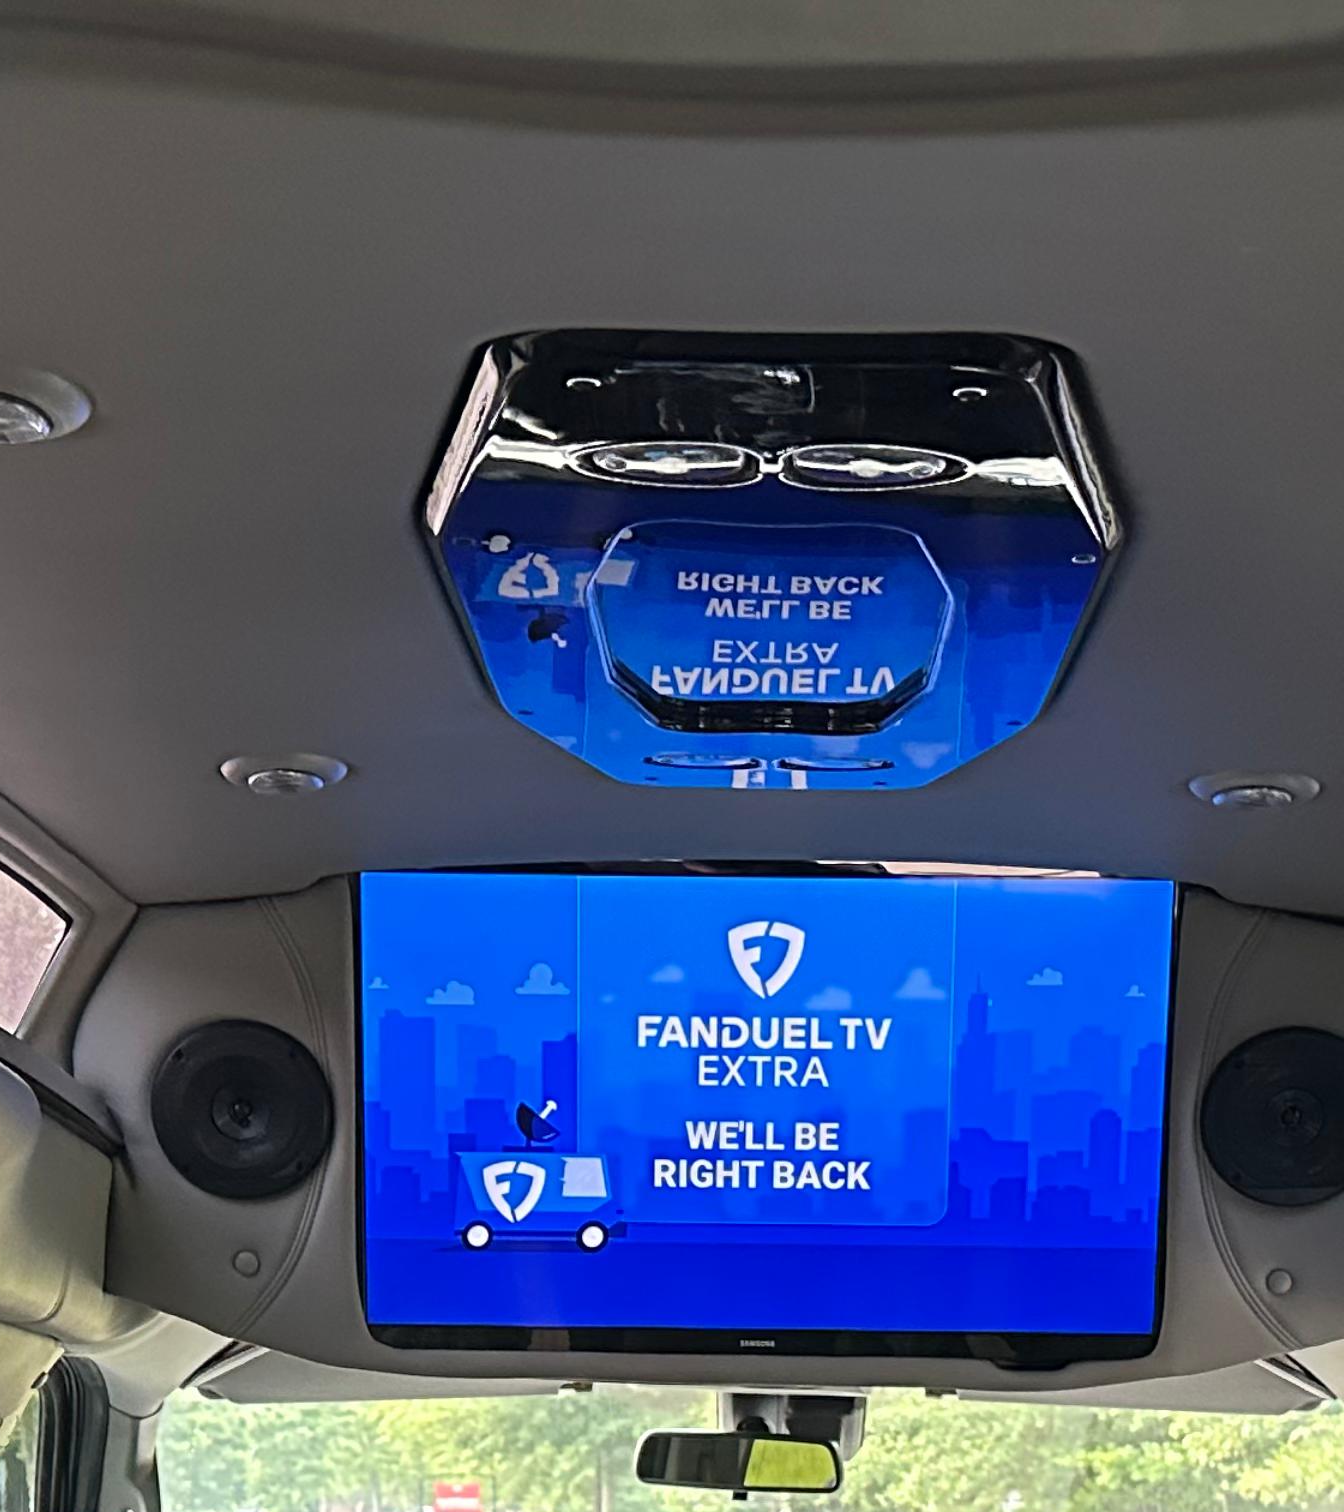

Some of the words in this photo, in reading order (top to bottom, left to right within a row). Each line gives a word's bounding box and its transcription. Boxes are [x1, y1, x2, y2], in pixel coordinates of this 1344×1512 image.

[637, 1016, 834, 1049] FANDUEL
[839, 1018, 893, 1050] TV
[698, 1055, 829, 1087] EXTRA
[685, 1120, 785, 1151] WE'LL
[794, 1122, 840, 1151] BE
[653, 1159, 765, 1189] RIGHT
[772, 1160, 871, 1190] BACK
